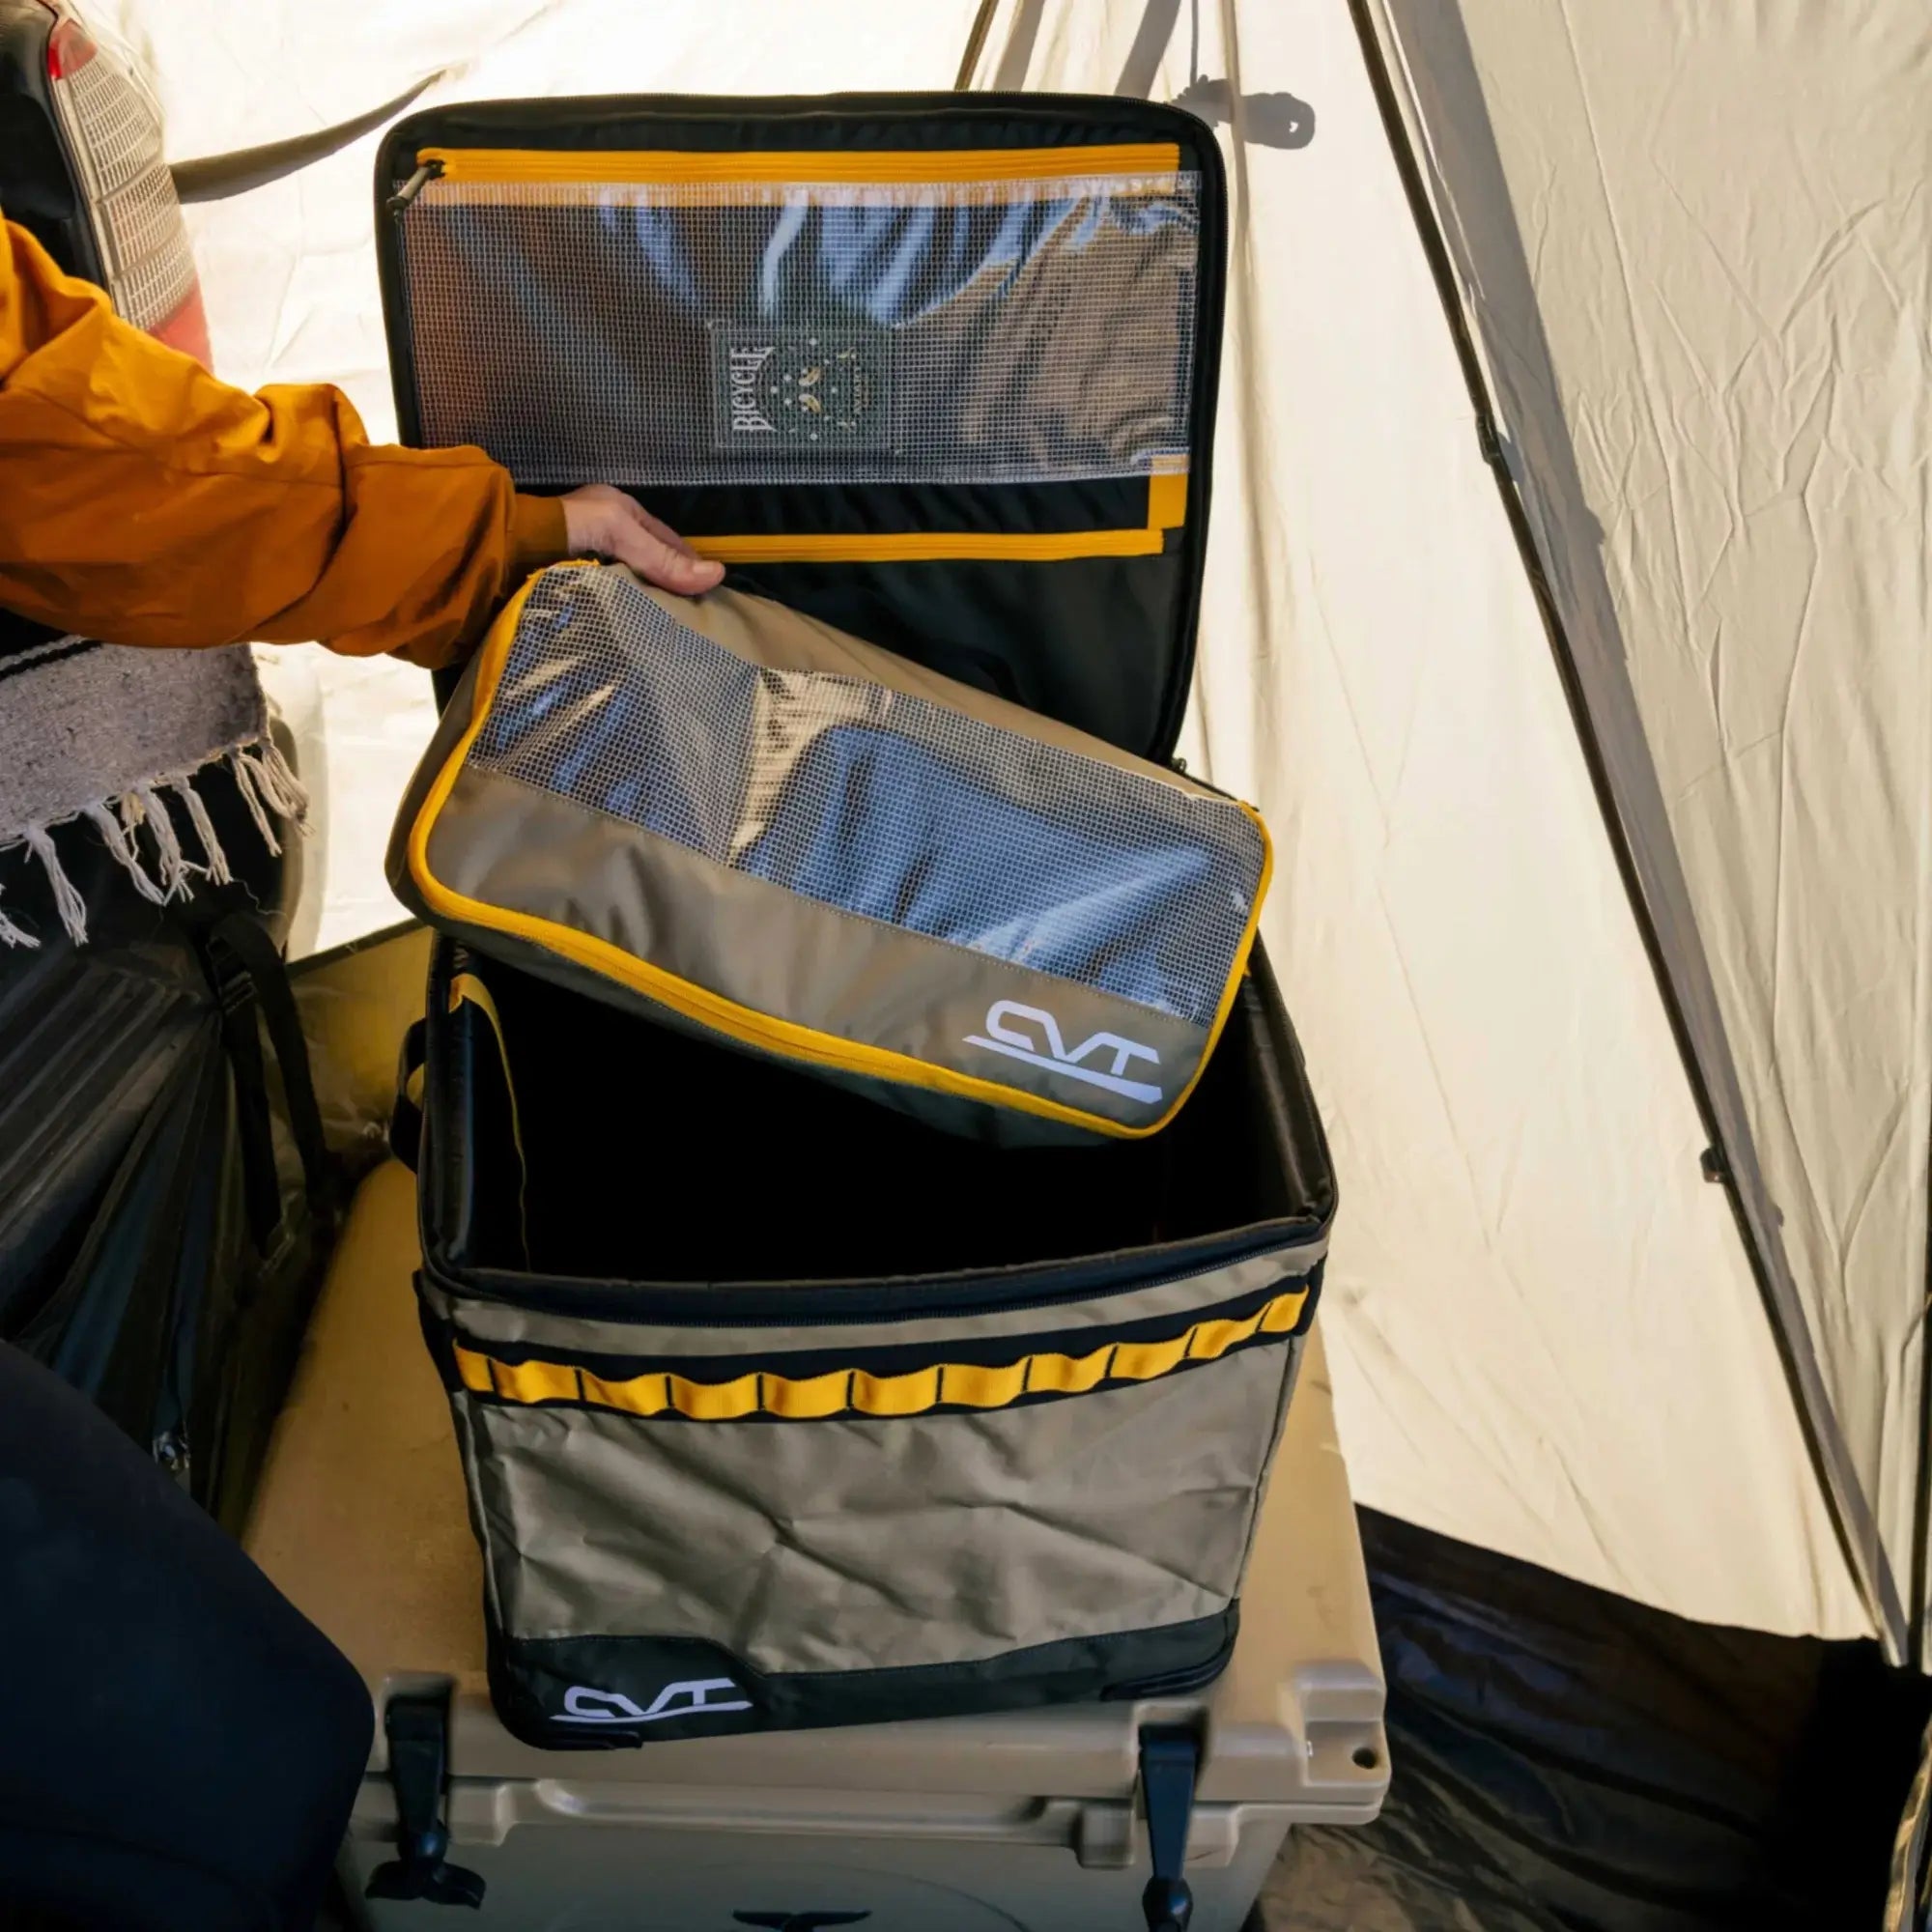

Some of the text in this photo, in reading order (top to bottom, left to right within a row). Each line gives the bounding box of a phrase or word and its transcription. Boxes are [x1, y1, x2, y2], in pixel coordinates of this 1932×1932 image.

[730, 346, 777, 432] BICYCLE
[985, 1000, 1161, 1076] CVT
[563, 1677, 736, 1719] CVT
